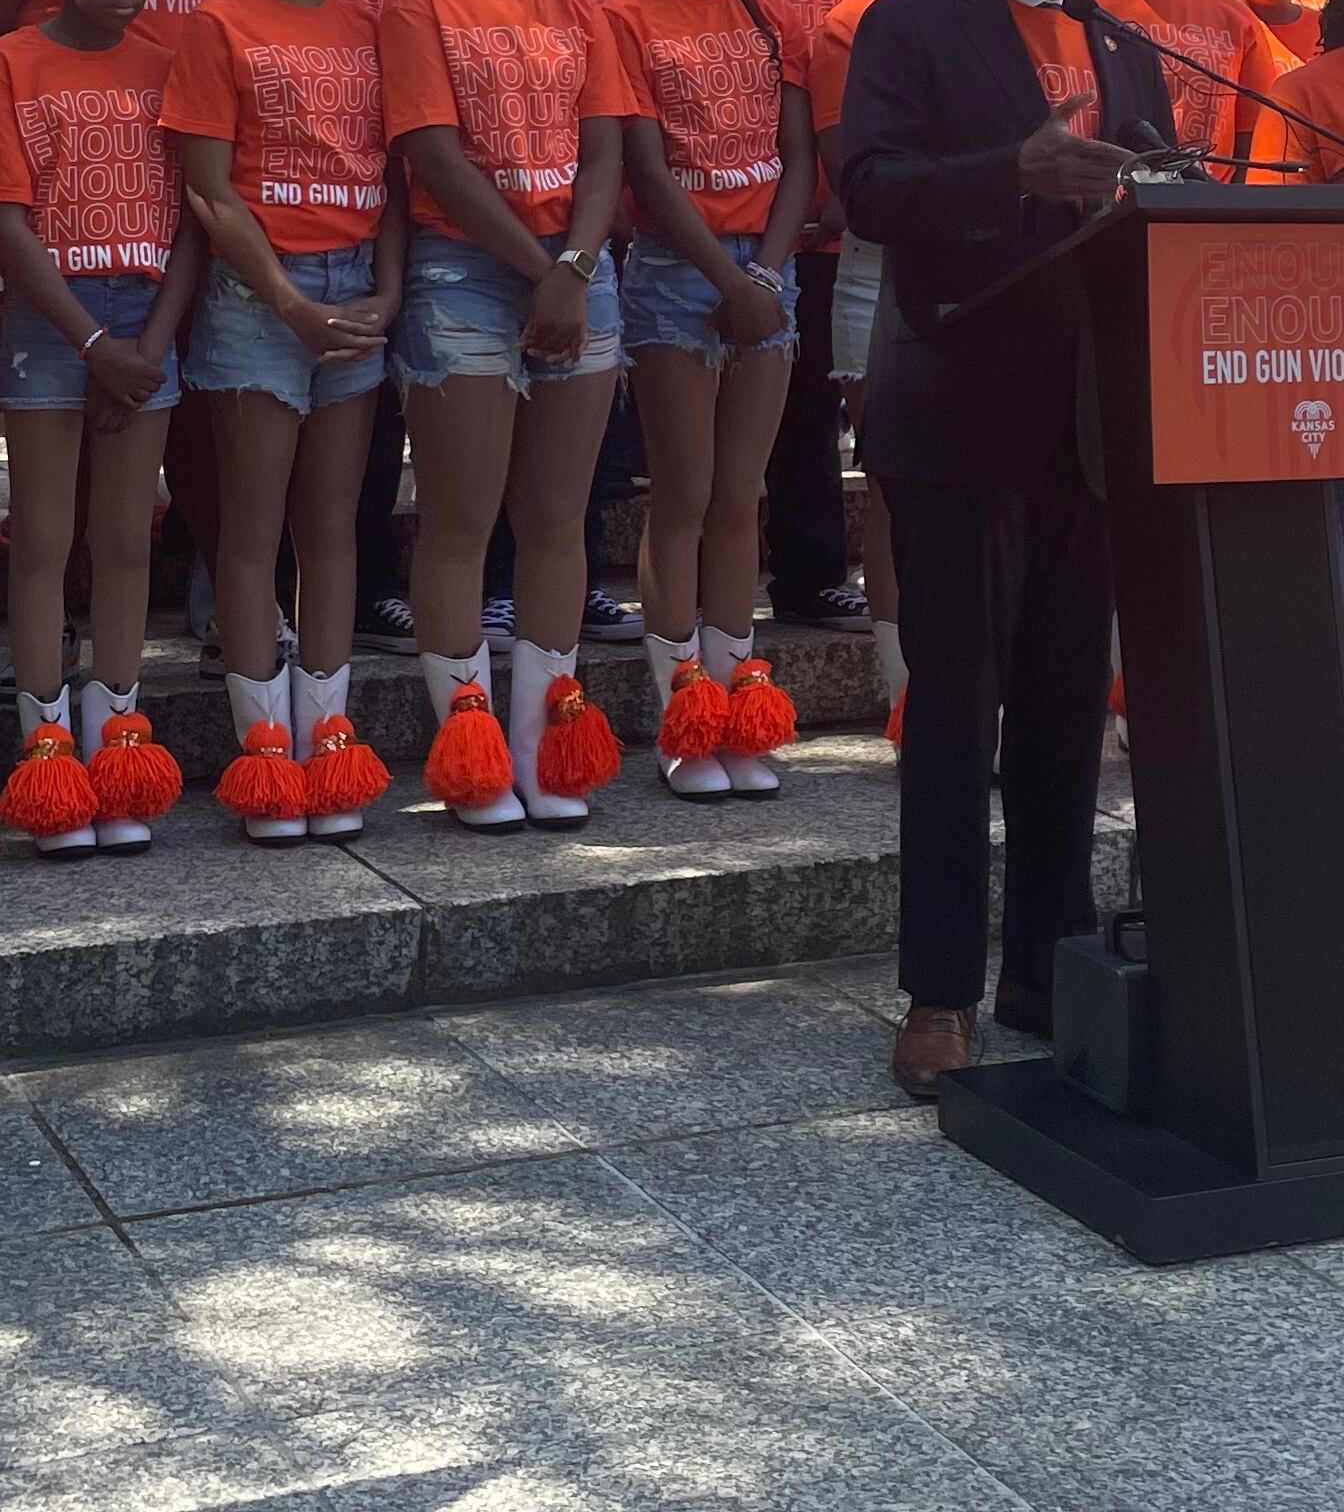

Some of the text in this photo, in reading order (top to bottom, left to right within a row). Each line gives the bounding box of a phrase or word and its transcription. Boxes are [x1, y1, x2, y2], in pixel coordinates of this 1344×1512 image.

[244, 44, 380, 81] ENOUG
[646, 27, 783, 71] ENOUG
[253, 76, 385, 117] ENOUG
[657, 56, 782, 104] ENOUG
[14, 88, 164, 138] ENOUG
[662, 91, 782, 136] ENOUG
[260, 114, 384, 152] ENOUG
[261, 180, 302, 206] END
[308, 182, 350, 208] GUN
[494, 168, 532, 193] GUN
[710, 166, 750, 191] GUN
[67, 244, 113, 272] GUN
[1202, 349, 1248, 385] END
[1255, 348, 1303, 384] GUN
[1291, 419, 1336, 445] KANSAS CITY
